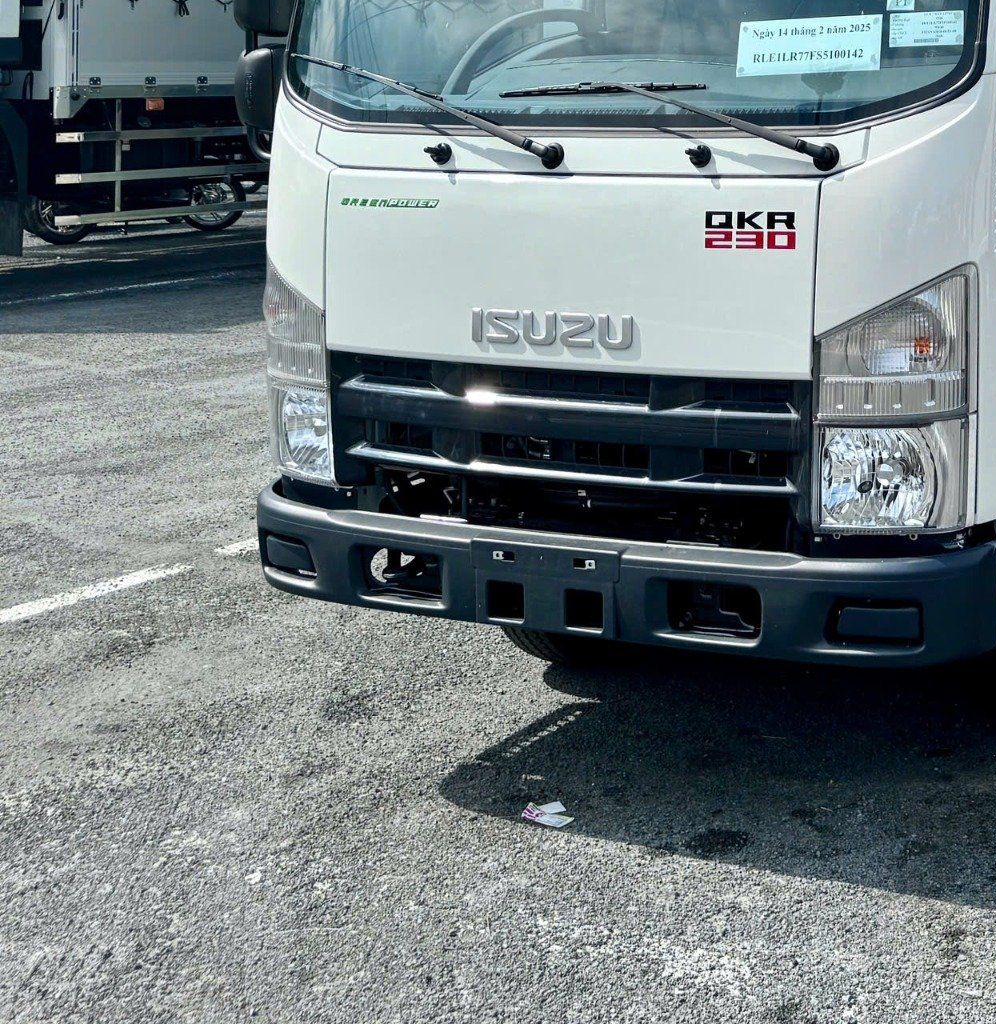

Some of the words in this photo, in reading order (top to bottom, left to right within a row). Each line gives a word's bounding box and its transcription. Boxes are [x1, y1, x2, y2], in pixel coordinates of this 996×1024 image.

[753, 28, 775, 39] Ngày
[779, 28, 788, 36] 14
[791, 27, 816, 36] tháng
[819, 26, 824, 34] 2
[827, 25, 847, 34] năm
[849, 23, 871, 33] 2025
[705, 211, 796, 230] QKR
[705, 231, 796, 250] 230
[471, 307, 634, 350] ISUZU
